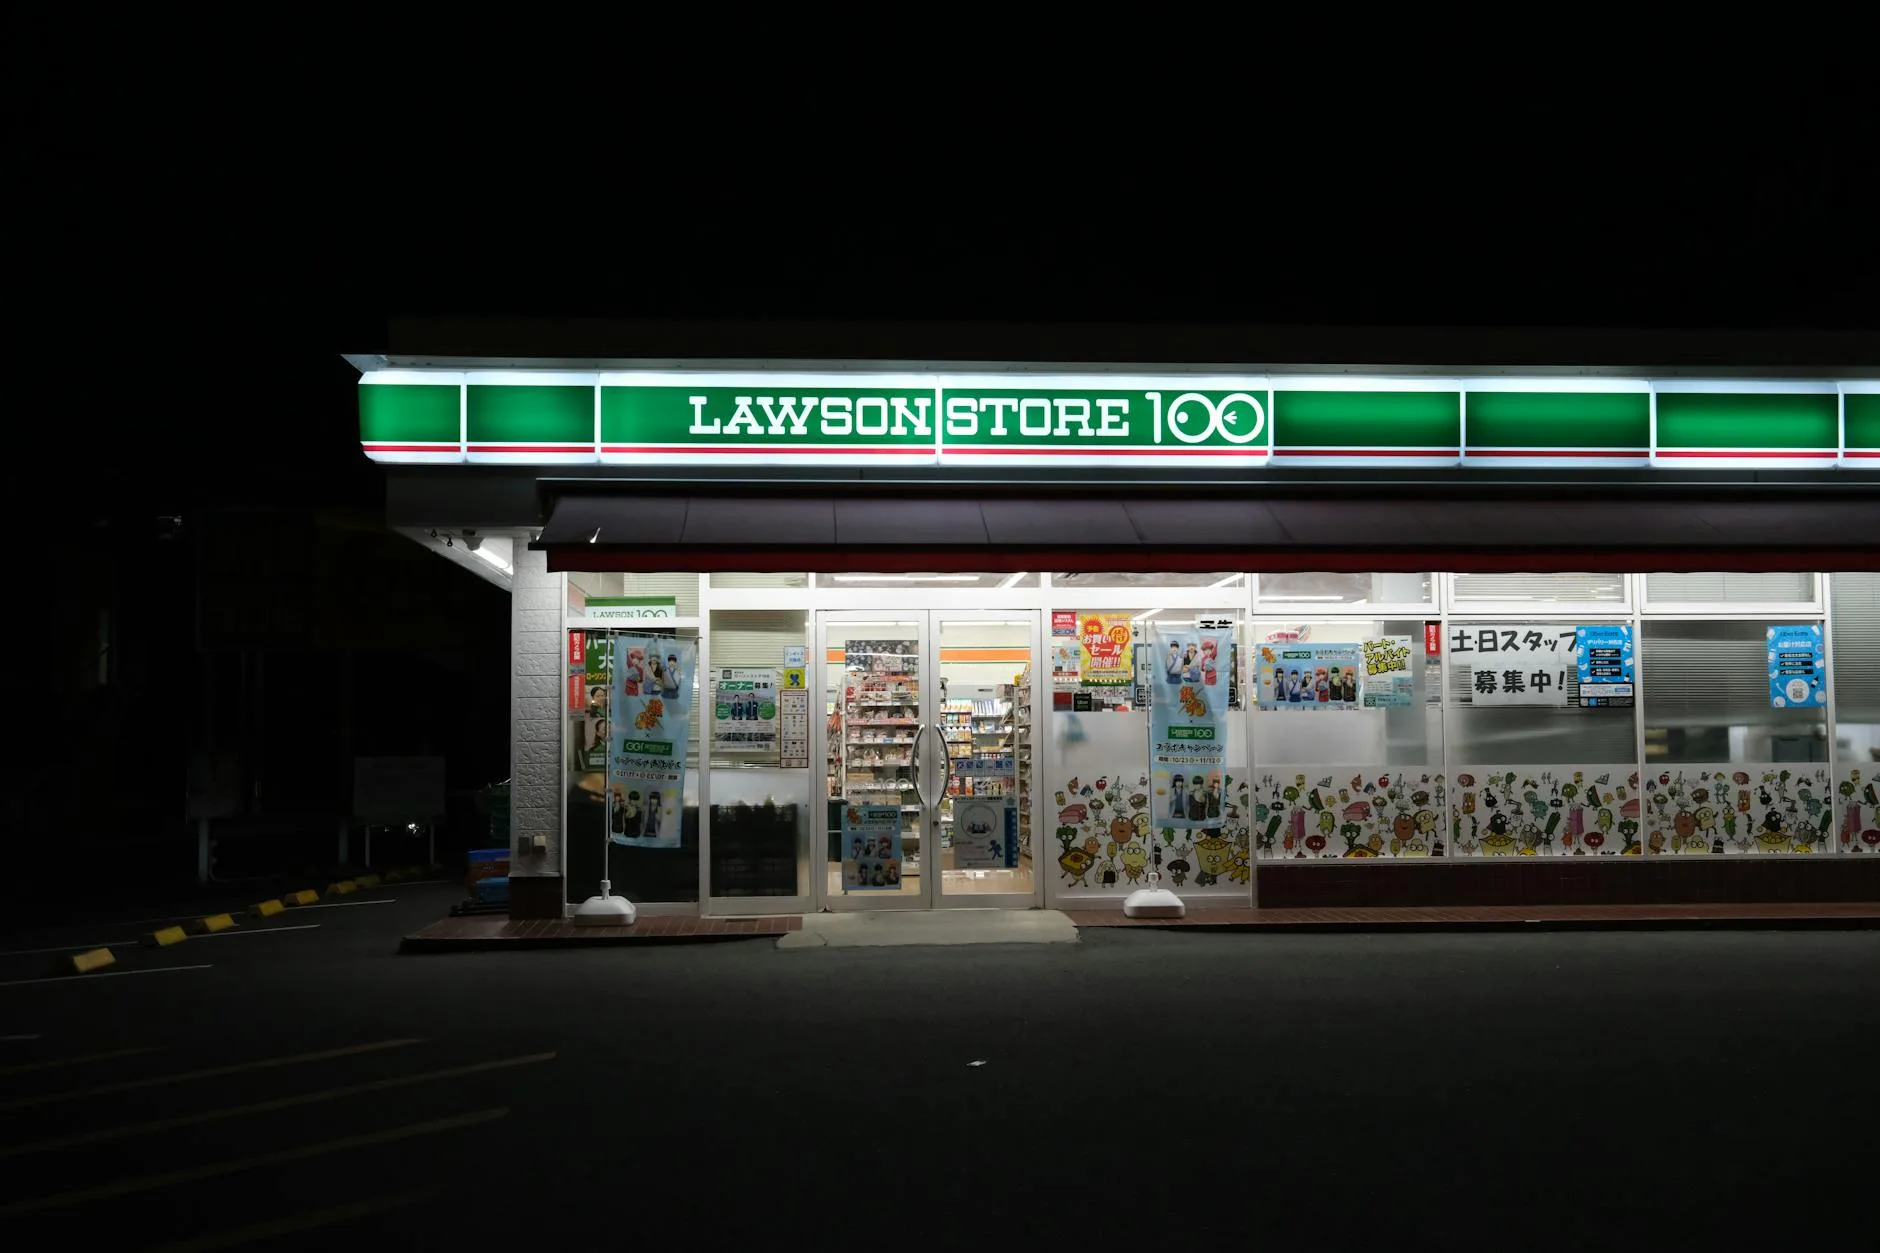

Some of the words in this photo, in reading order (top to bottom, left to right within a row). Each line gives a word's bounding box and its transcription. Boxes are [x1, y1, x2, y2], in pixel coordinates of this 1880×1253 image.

[688, 395, 932, 436] LAWSON
[946, 397, 1130, 437] STORE
[1145, 391, 1265, 444] 100
[1091, 645, 1122, 656] セール
[1365, 647, 1410, 664] アルバイト
[720, 682, 753, 690] オーナー
[1474, 670, 1566, 694] 募集中!
